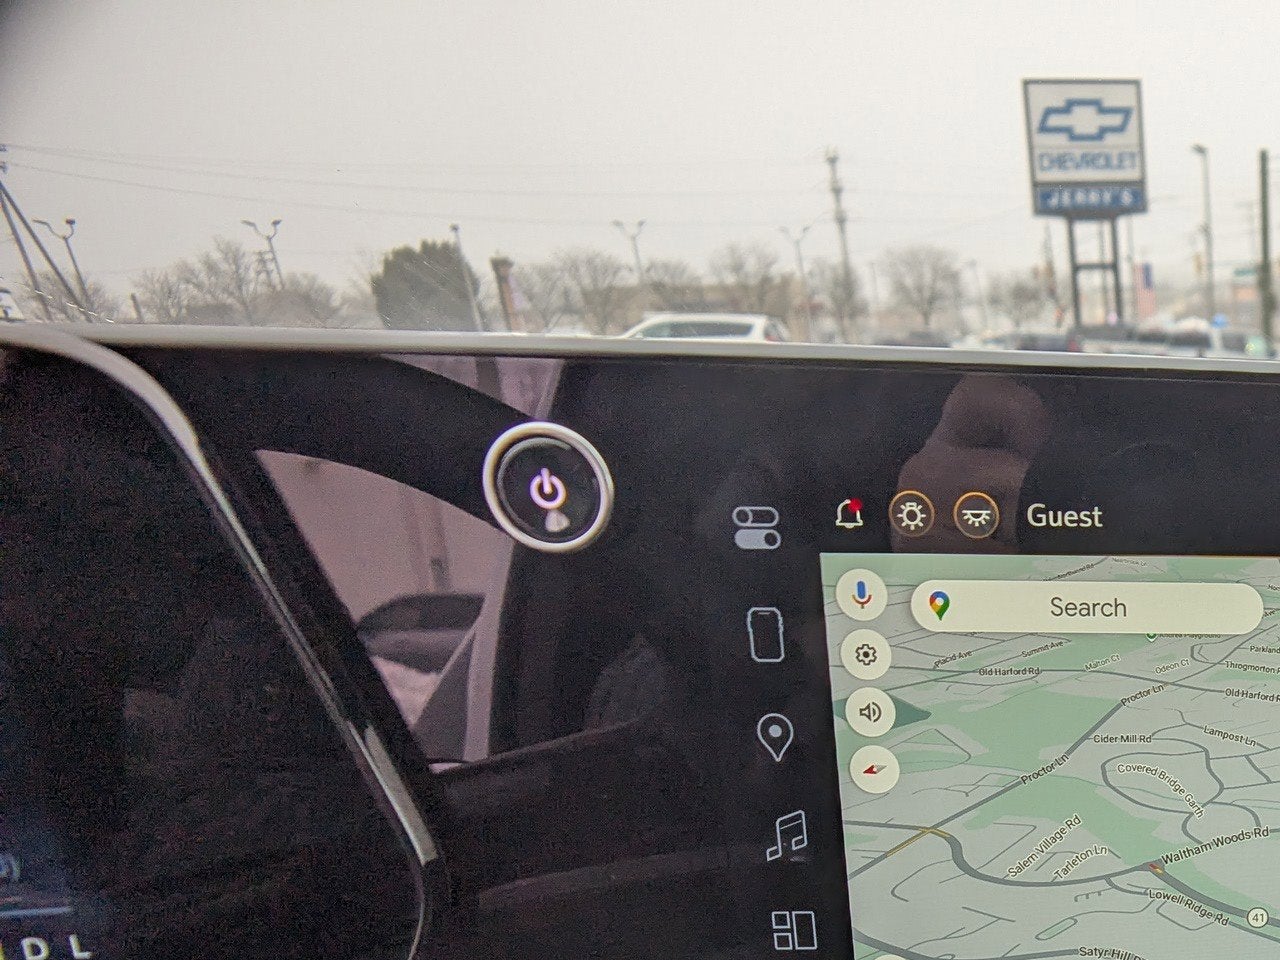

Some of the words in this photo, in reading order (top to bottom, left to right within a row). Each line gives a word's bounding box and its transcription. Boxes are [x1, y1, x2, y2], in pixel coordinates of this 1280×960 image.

[1027, 503, 1103, 528] Guest
[1050, 596, 1127, 617] Search
[934, 654, 957, 668] Placid
[958, 651, 972, 659] Ave
[1021, 645, 1049, 658] Summit
[978, 668, 993, 676] Old
[994, 668, 1026, 676] Harford
[1084, 657, 1110, 672] Malton
[1111, 654, 1121, 662] Ct
[1155, 662, 1179, 675] Odeon
[1180, 658, 1190, 667] Ct
[1225, 661, 1275, 673] Throgmorton
[1121, 689, 1150, 706] Proctor
[1151, 684, 1165, 694] Ln
[1225, 688, 1240, 698] Old
[1241, 690, 1275, 701] Harford
[1093, 734, 1119, 743] Cider
[1120, 734, 1138, 743] Mill
[1139, 734, 1152, 743] Rd
[1203, 725, 1243, 743] Lampost
[1243, 736, 1257, 747] Ln
[1020, 761, 1057, 785] Proctor
[1055, 753, 1069, 768] Ln
[1117, 763, 1158, 777] Covered
[1157, 771, 1186, 796] Bridge
[1184, 793, 1204, 819] Garth
[1007, 850, 1037, 878] Salem
[1035, 827, 1068, 856] Village
[1064, 814, 1082, 834] Rd
[1161, 842, 1212, 865] Waltham
[1212, 830, 1252, 849] Woods
[1254, 826, 1269, 838] Rd
[1054, 850, 1094, 880] Tarleton
[1093, 845, 1108, 856] Ln
[1148, 889, 1184, 905] Lowell
[1184, 898, 1213, 920] Ridge
[1213, 913, 1230, 926] Rd
[1252, 913, 1265, 923] 41
[68, 934, 92, 960] L
[1079, 947, 1109, 958] Satyr
